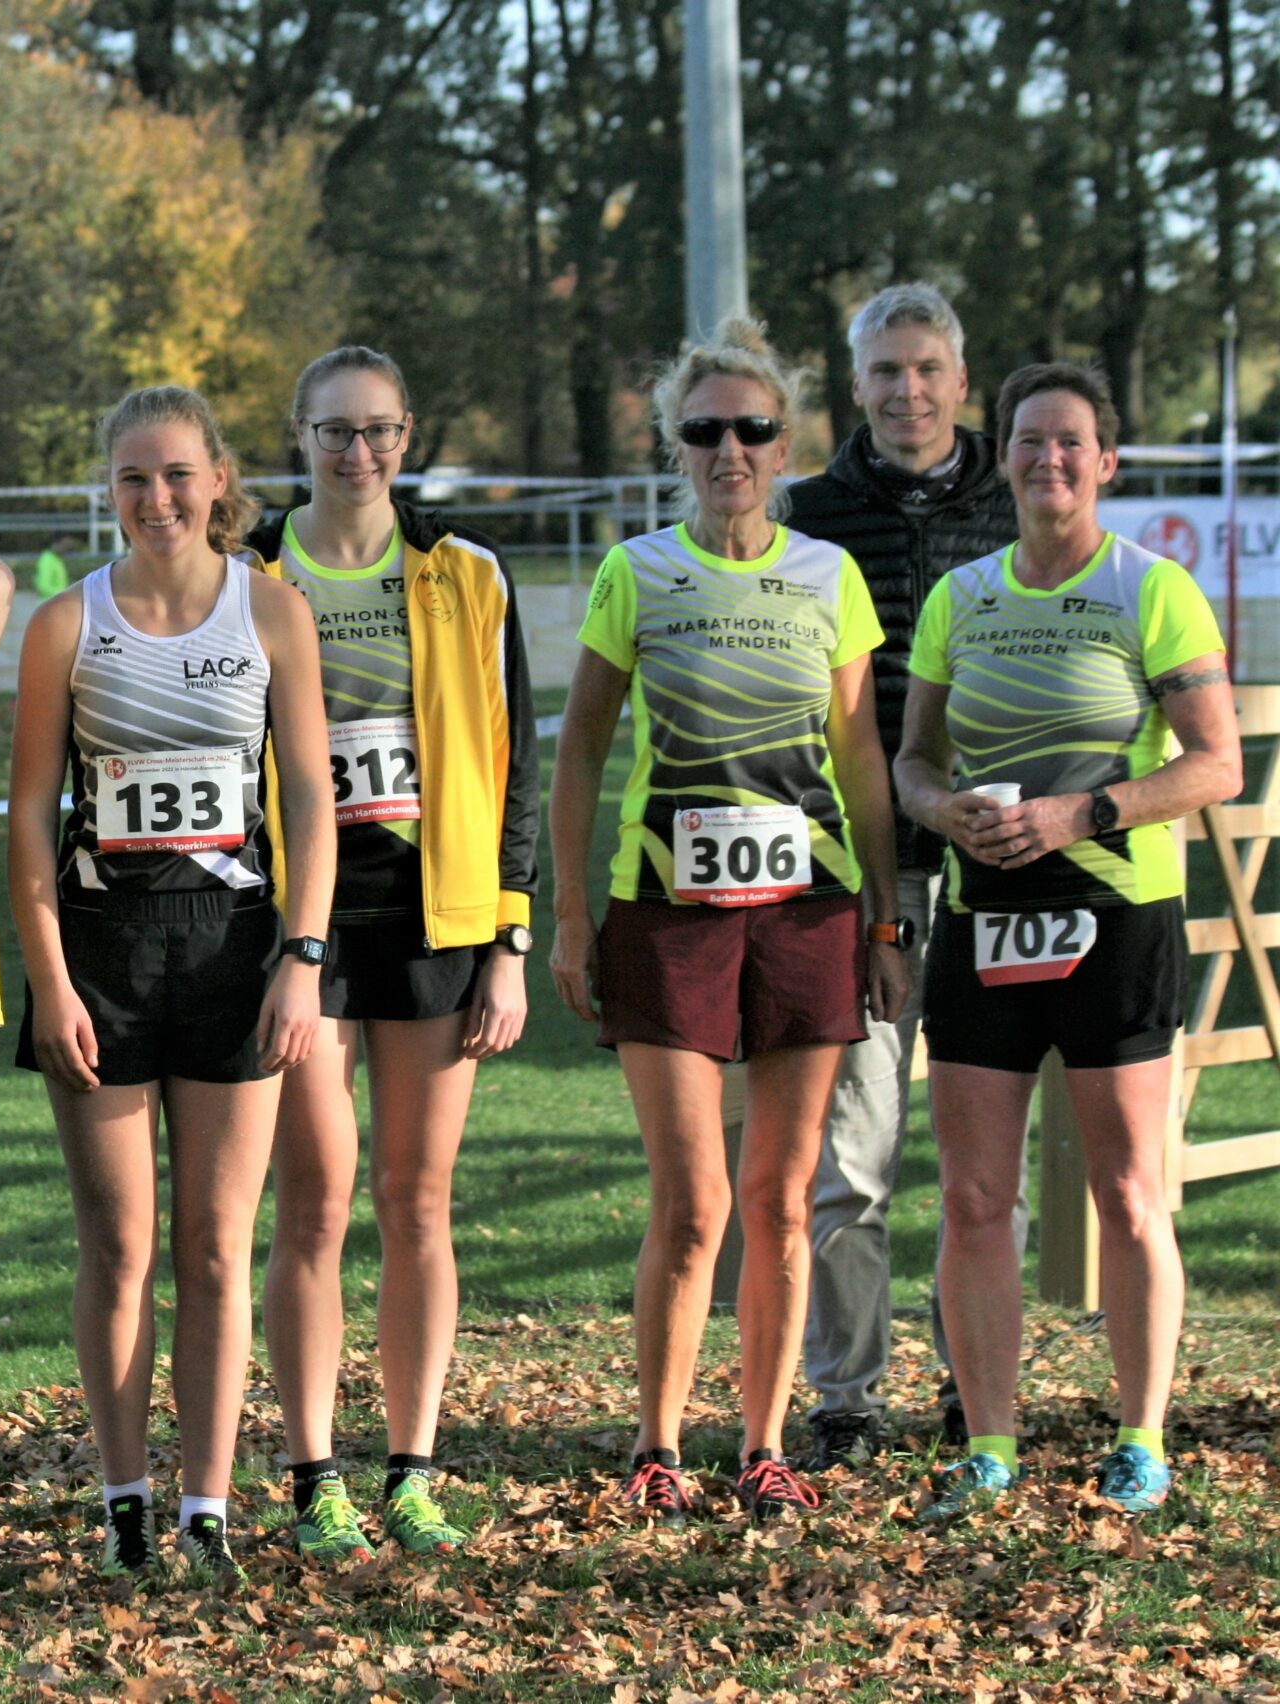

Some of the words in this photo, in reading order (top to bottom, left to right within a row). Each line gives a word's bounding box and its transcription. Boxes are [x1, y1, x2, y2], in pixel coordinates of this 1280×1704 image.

[319, 625, 407, 643] MENDEN
[668, 617, 820, 640] MARATHON-CLUB
[965, 627, 1111, 644] MARATHON-CLUB
[93, 647, 123, 655] erima
[709, 636, 791, 650] MENDEN
[992, 644, 1068, 656] MENDEN
[183, 656, 236, 679] LAC
[185, 680, 219, 690] VELTINS
[329, 747, 420, 803] 312
[116, 780, 223, 833] 133
[125, 842, 153, 852] Sarah
[155, 841, 218, 852] Schäperklaus
[690, 833, 797, 884] 306
[709, 893, 746, 903] Barbara
[985, 909, 1082, 962] 702
